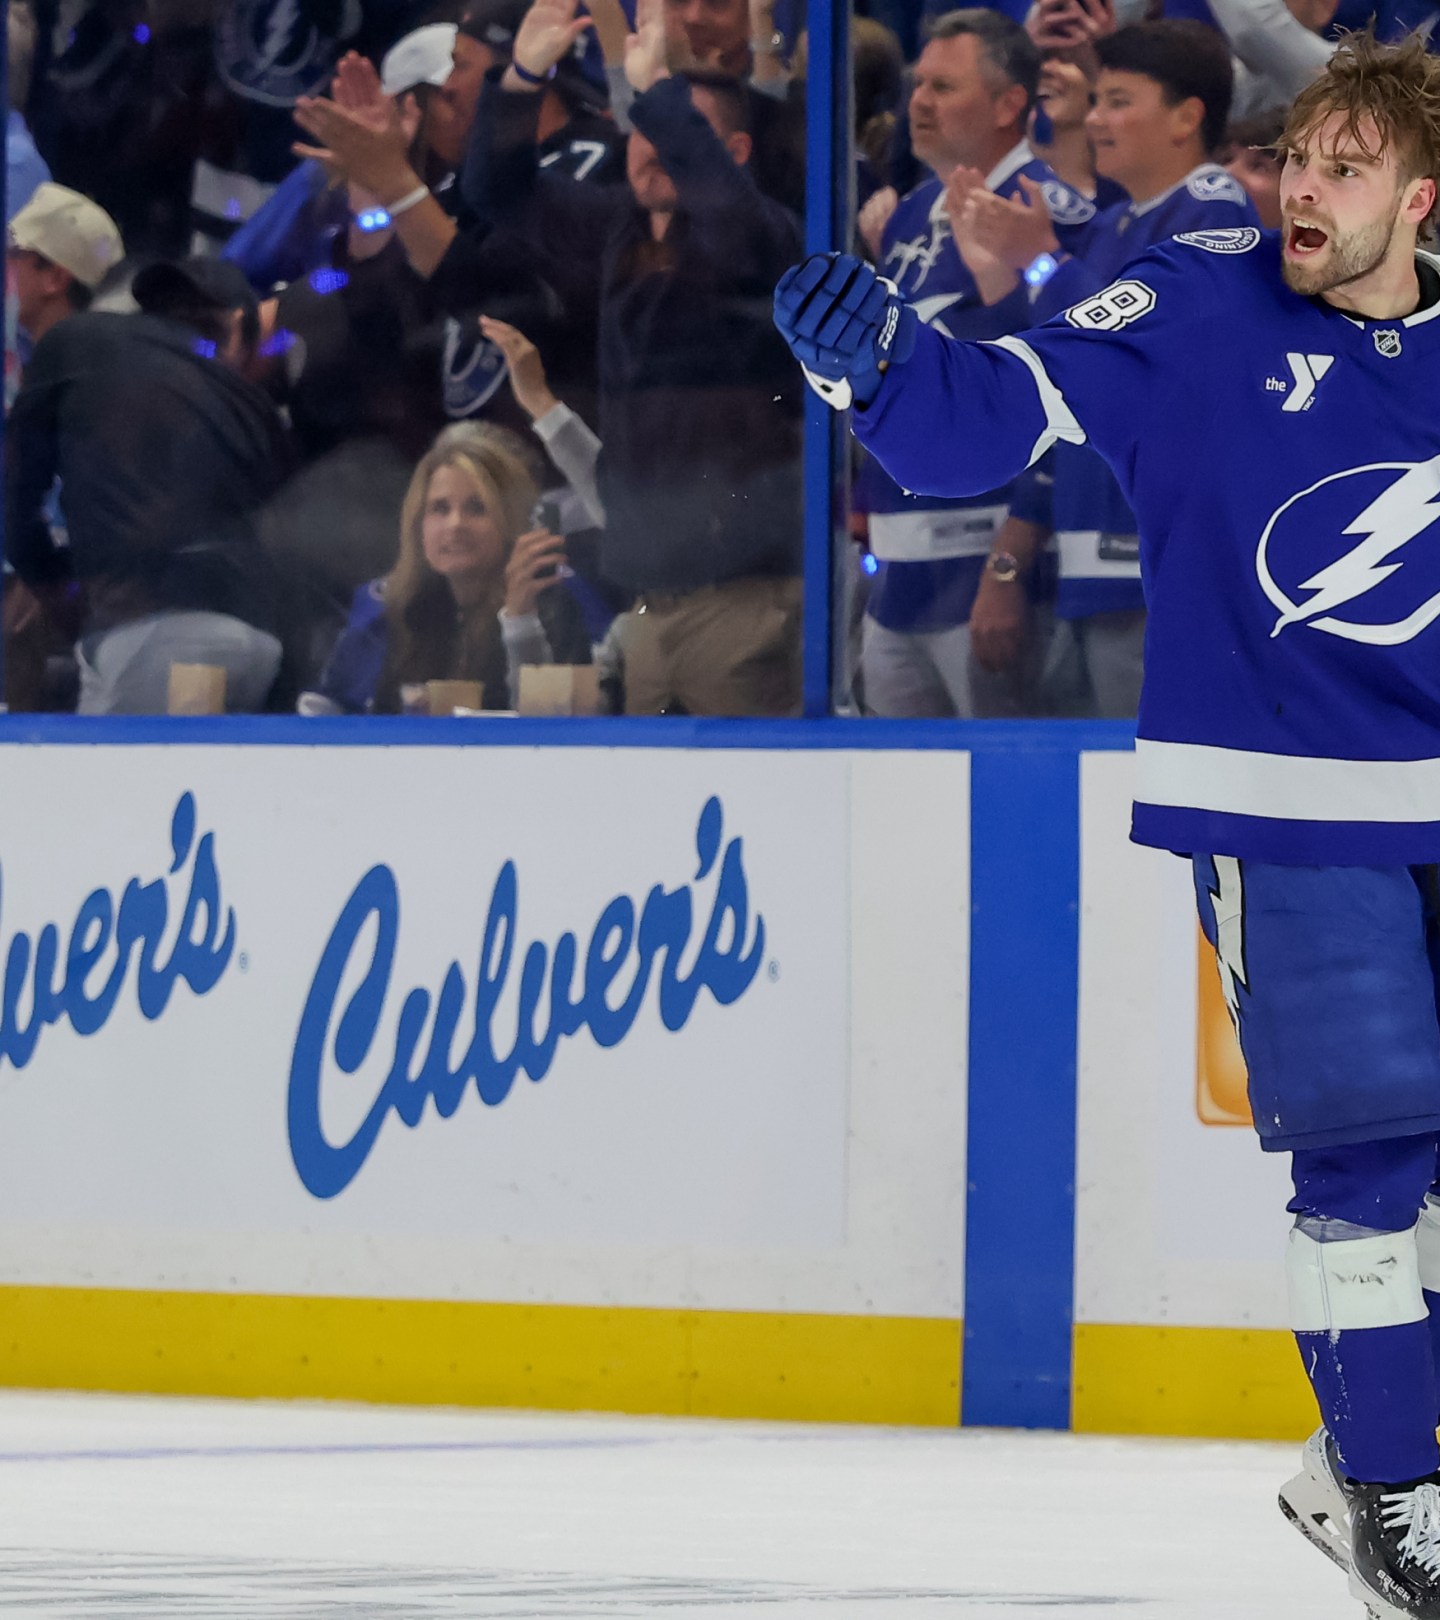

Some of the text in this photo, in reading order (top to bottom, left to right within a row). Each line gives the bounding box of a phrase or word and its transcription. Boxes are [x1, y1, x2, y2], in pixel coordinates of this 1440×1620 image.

[1064, 279, 1158, 332] 8
[1265, 352, 1335, 412] the Y
[0, 790, 236, 1069] ver's
[288, 795, 764, 1199] Culver's
[1376, 1569, 1411, 1602] BAUER
